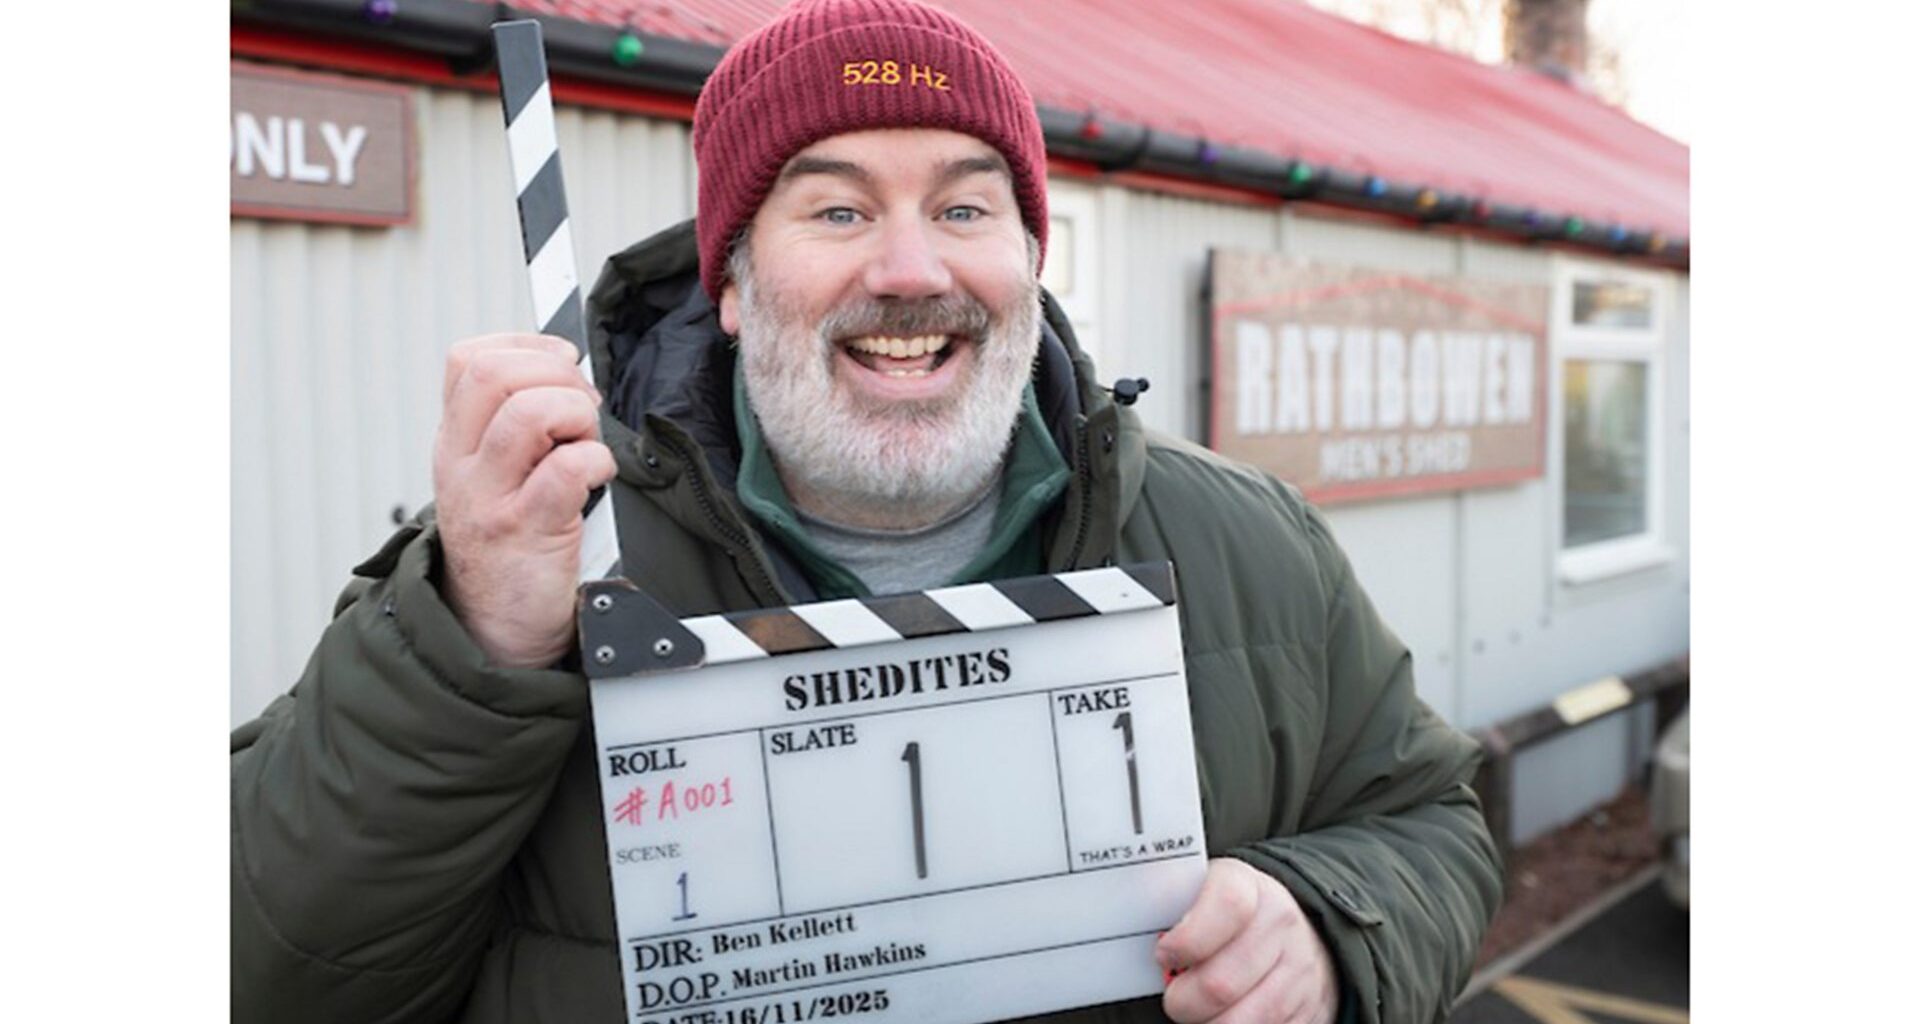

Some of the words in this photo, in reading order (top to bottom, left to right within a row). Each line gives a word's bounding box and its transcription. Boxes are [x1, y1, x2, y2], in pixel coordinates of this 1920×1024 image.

[843, 60, 901, 85] 528
[910, 63, 951, 91] Hz
[230, 112, 367, 186] NLY
[1236, 321, 1534, 434] RATHBOWEN
[1408, 433, 1471, 473] SHED
[783, 648, 1012, 711] SHEDITES
[1058, 687, 1131, 715] TAKE
[609, 747, 686, 777] ROLL
[771, 724, 857, 755] SLATE
[1112, 711, 1143, 834] 1
[901, 741, 928, 879] 1
[616, 843, 682, 864] SCENE
[1079, 846, 1133, 863] THAT'S
[1137, 843, 1148, 854] A
[1151, 836, 1194, 853] WRAP
[672, 871, 698, 922] 1
[633, 938, 704, 973] DIR:
[712, 930, 762, 955] Ben
[769, 912, 858, 945] Kellett
[637, 972, 726, 1010] D.O.P.
[731, 961, 817, 990] Martin
[823, 940, 928, 976] Hawkins
